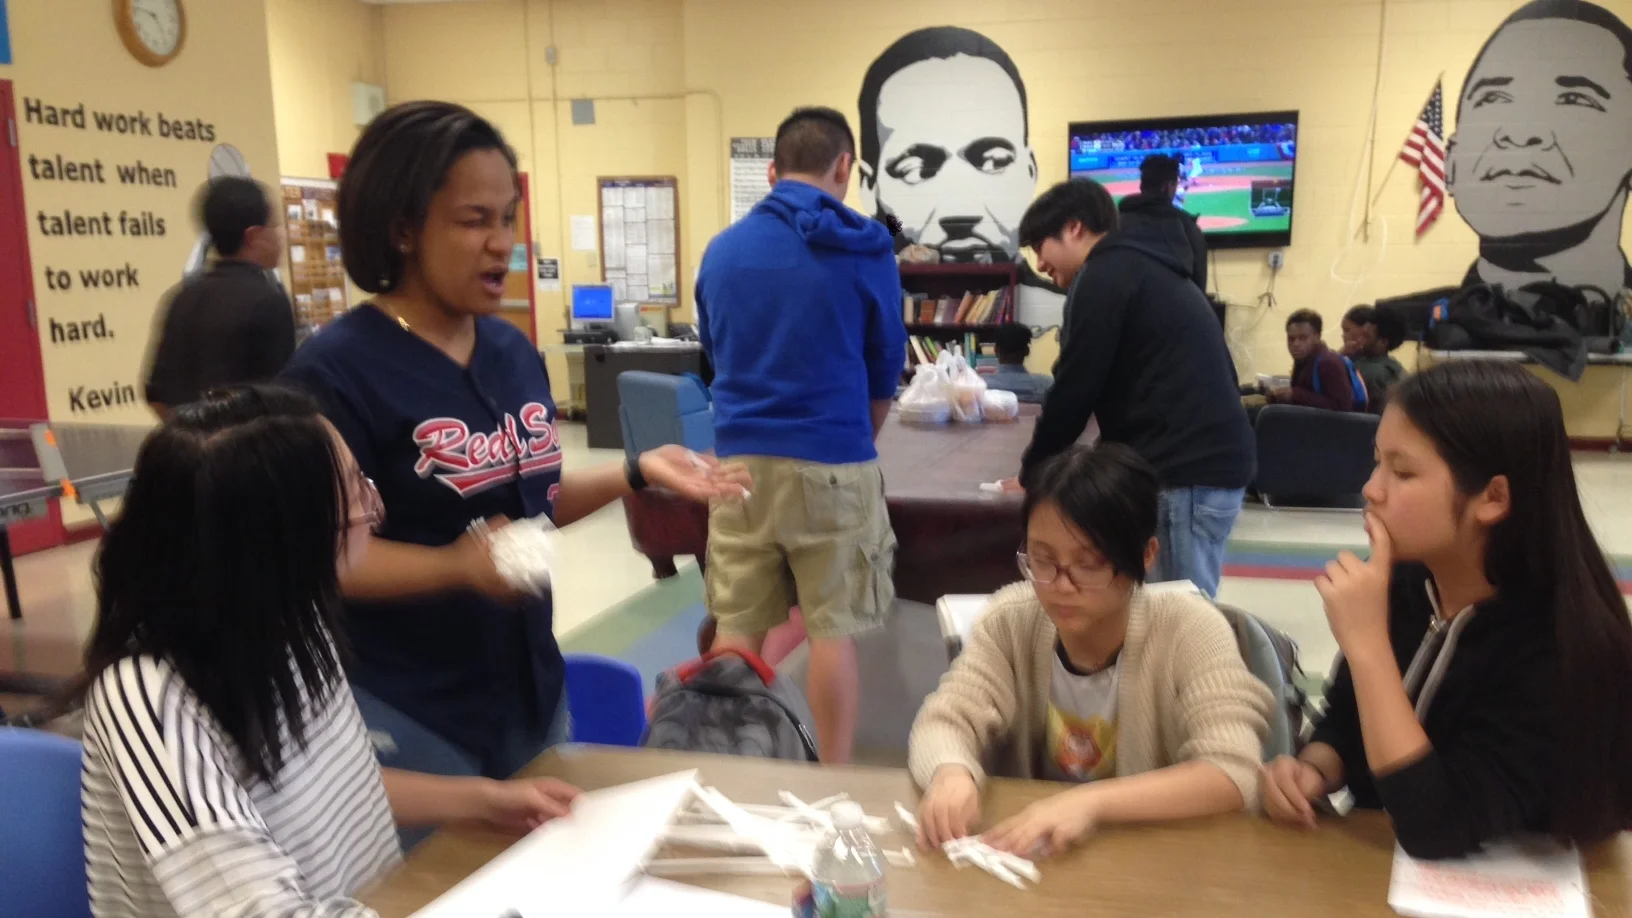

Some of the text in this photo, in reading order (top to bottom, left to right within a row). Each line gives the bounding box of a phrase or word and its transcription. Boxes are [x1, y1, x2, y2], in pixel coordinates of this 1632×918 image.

[23, 97, 217, 142] Hard work beats
[28, 154, 178, 188] talent when
[37, 210, 166, 236] talent fails
[45, 263, 140, 290] to work
[49, 314, 115, 343] hard.
[67, 382, 136, 412] Kevin
